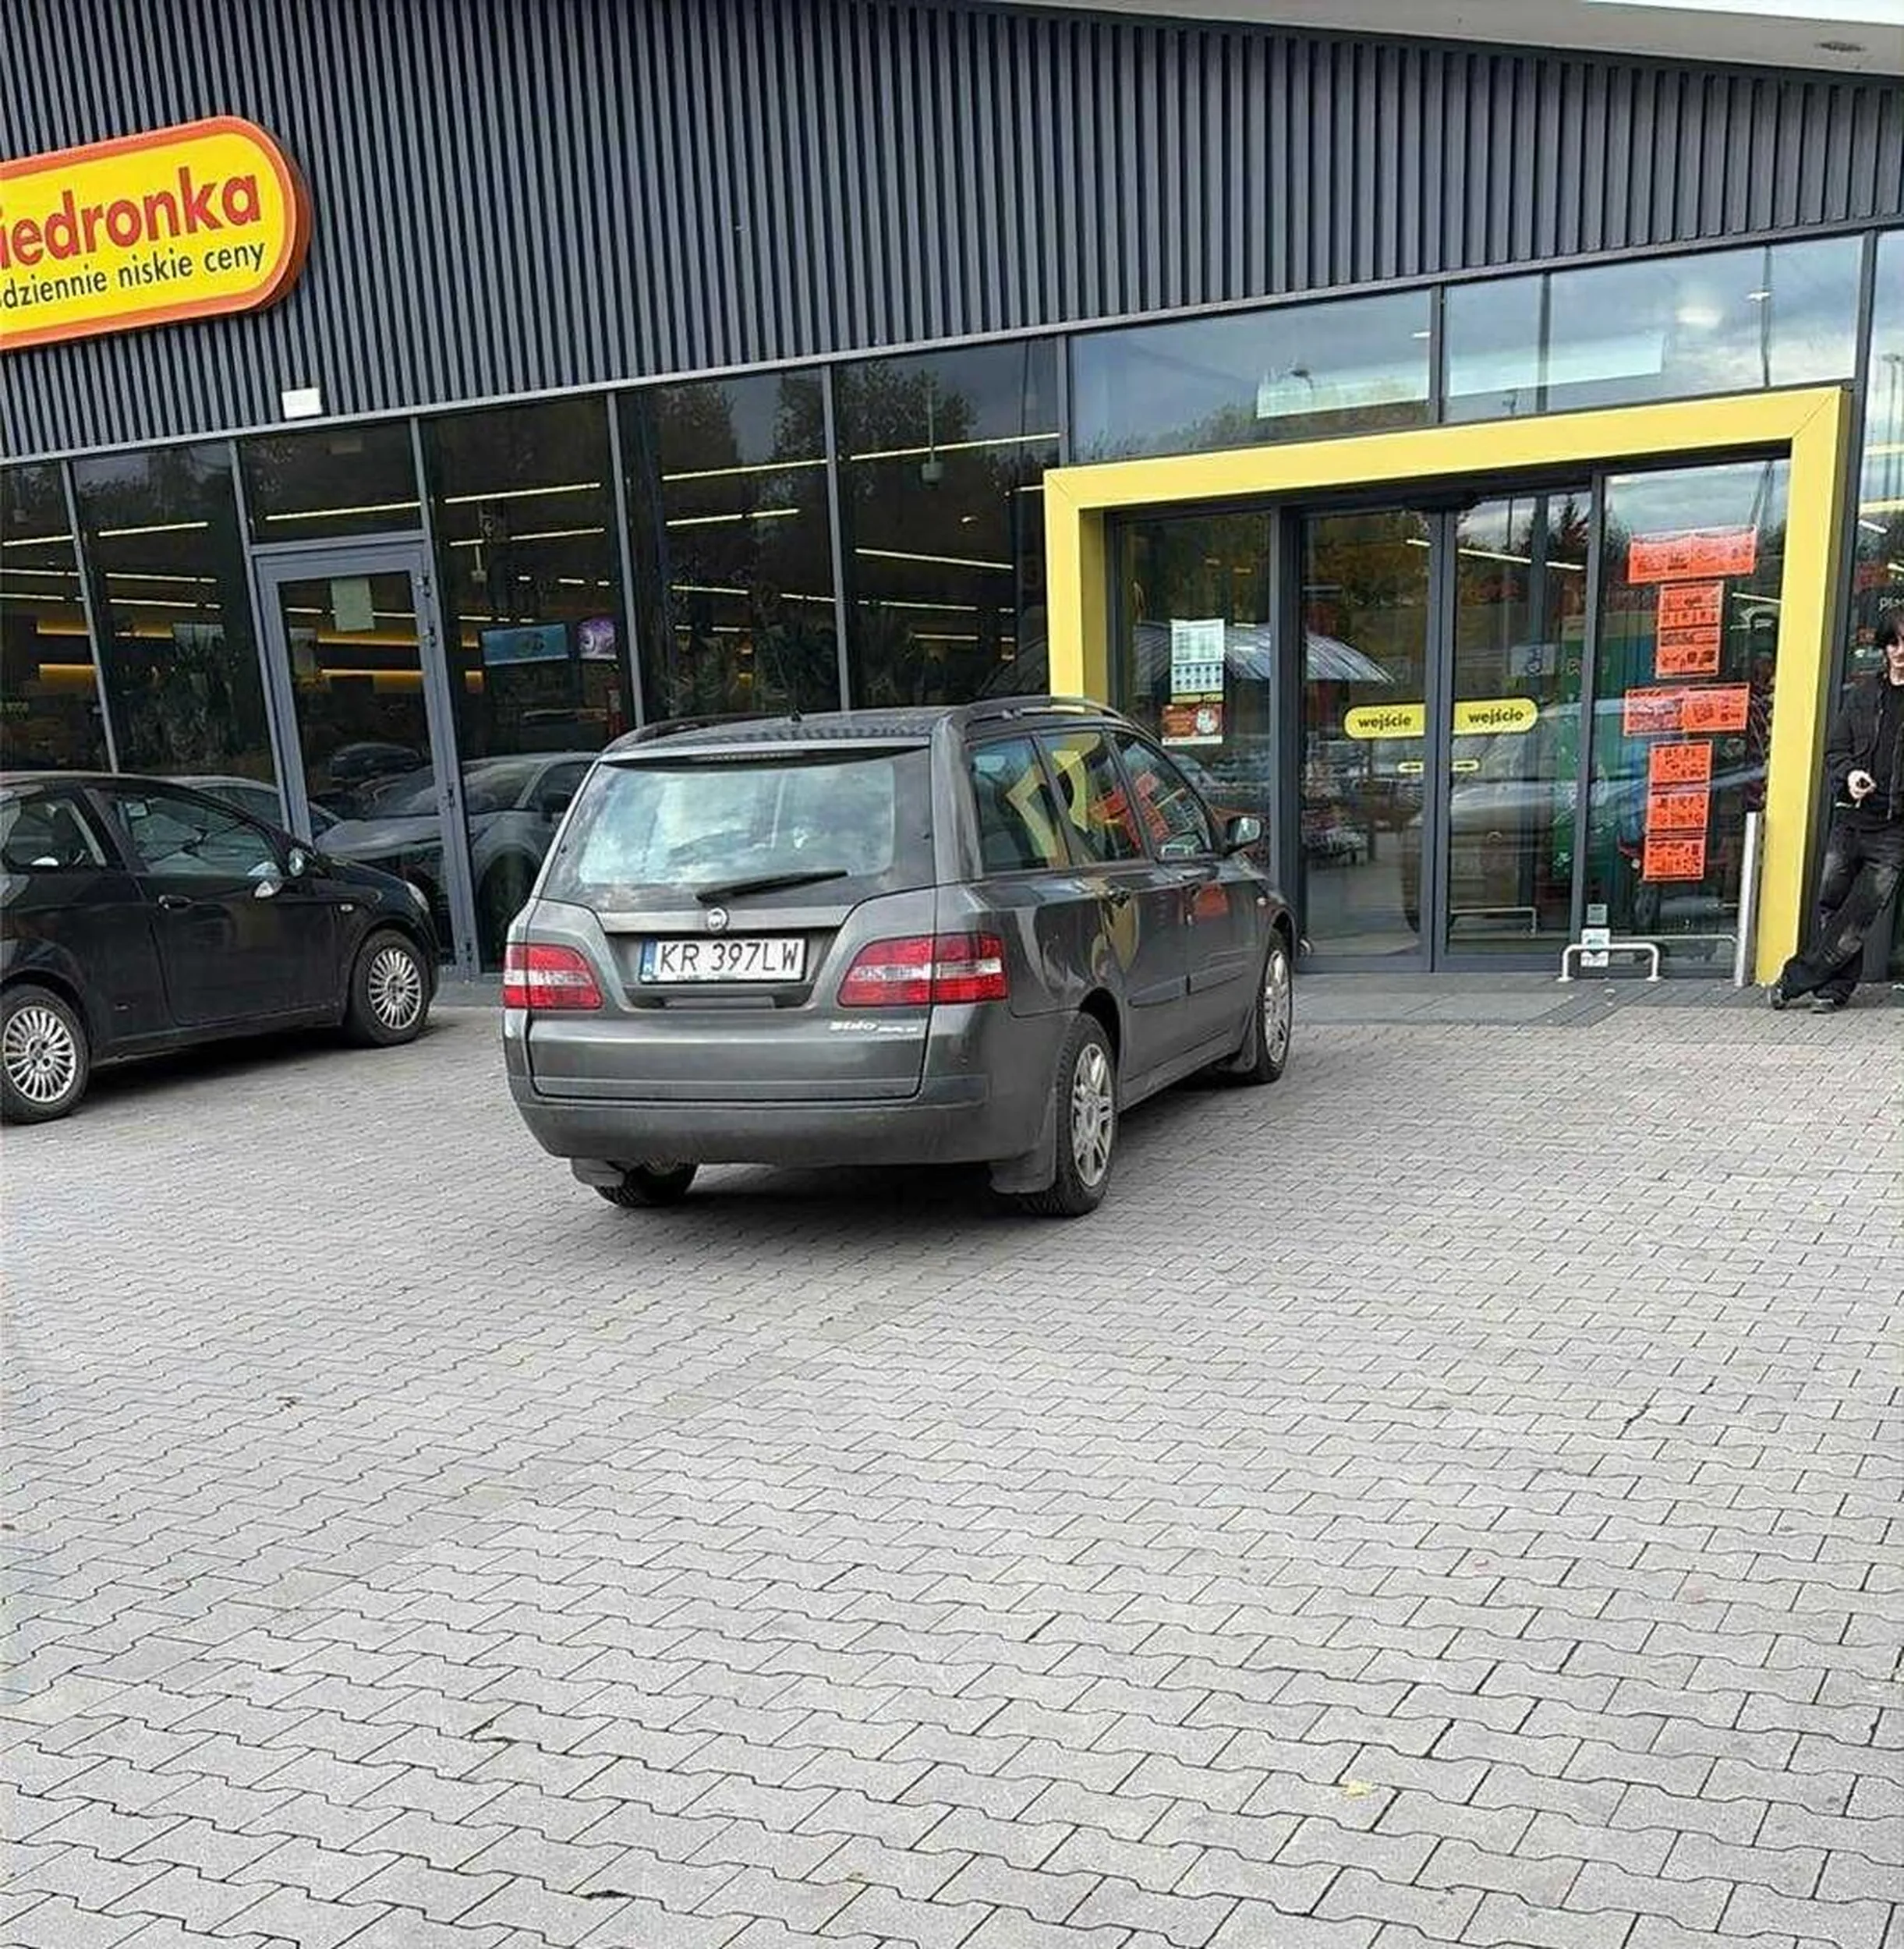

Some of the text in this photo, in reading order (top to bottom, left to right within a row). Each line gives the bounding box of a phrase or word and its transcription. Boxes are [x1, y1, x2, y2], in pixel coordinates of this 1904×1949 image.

[0, 242, 266, 310] dziennie niskie ceny
[1357, 713, 1412, 730] wejście
[660, 942, 799, 972] KR 397LW
